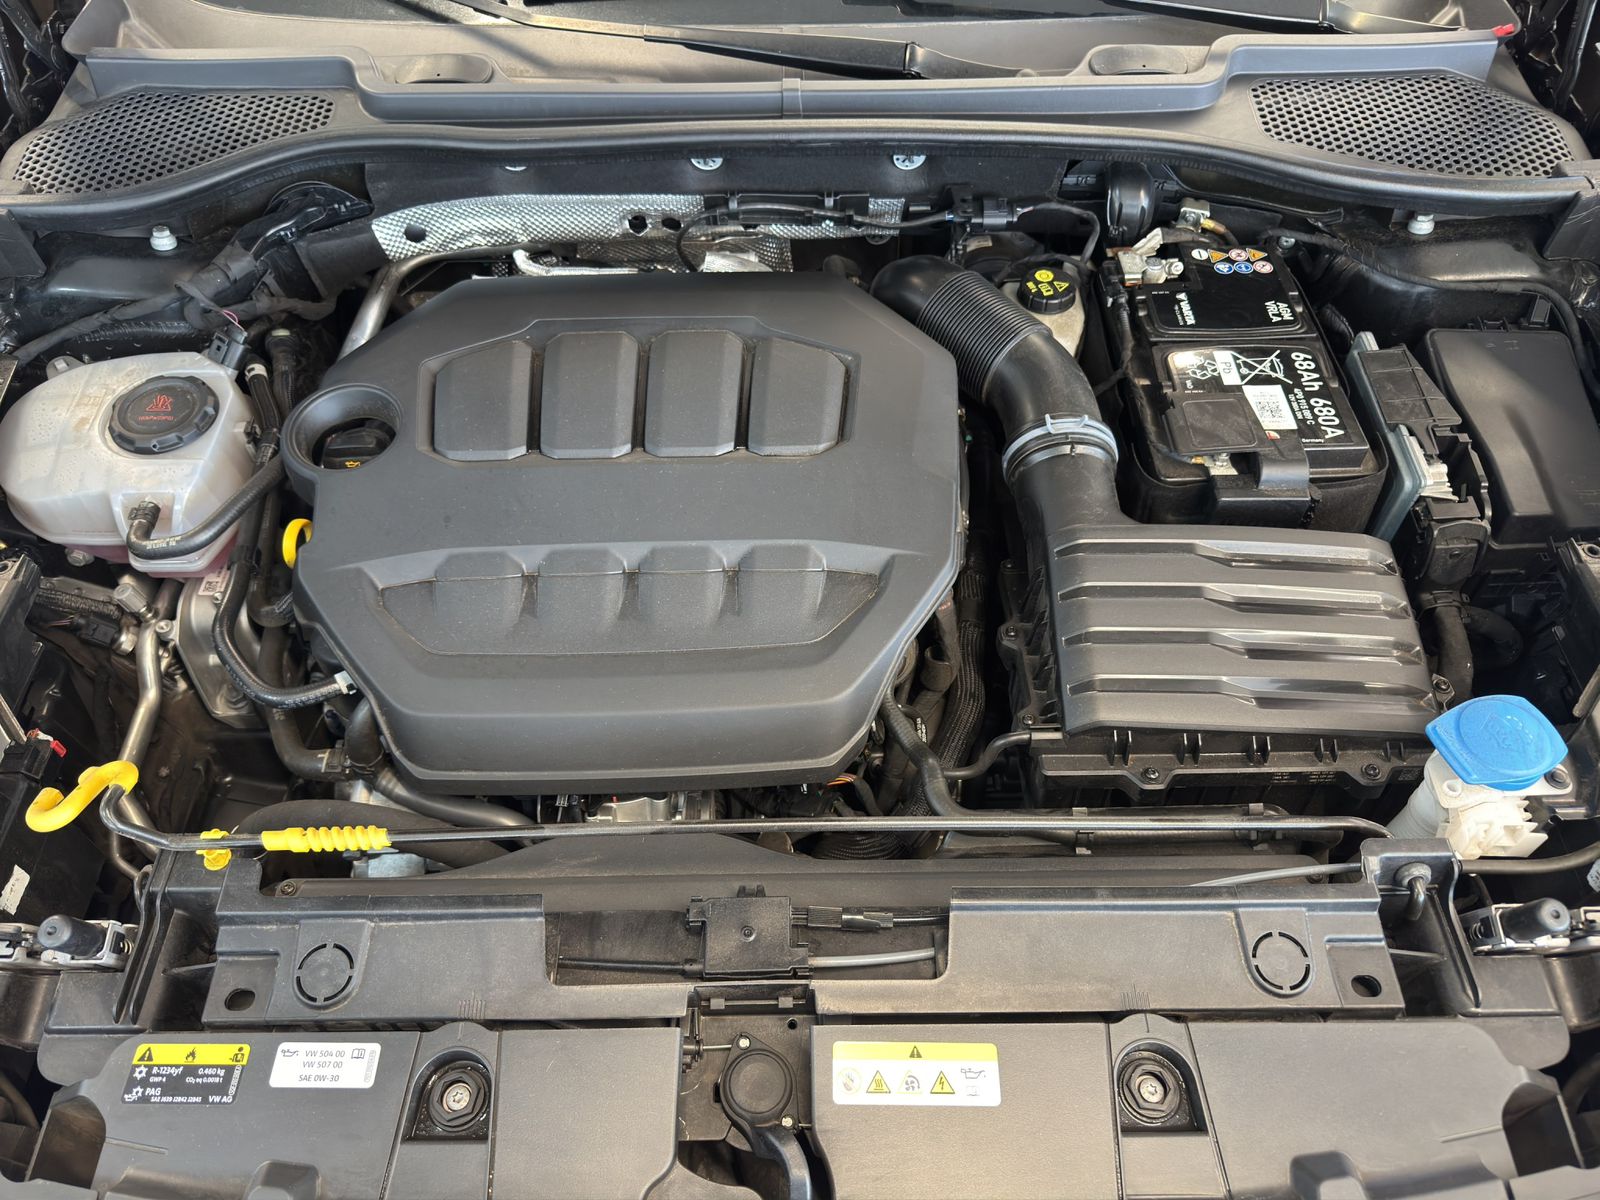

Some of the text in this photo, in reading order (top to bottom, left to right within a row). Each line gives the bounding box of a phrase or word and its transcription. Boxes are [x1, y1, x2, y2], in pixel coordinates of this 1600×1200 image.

[1180, 300, 1196, 325] VARTA
[1264, 300, 1282, 322] VRLA
[1276, 301, 1294, 320] AGM
[1221, 361, 1232, 374] Pb
[1291, 352, 1345, 439] 68Ah 680A
[319, 1050, 333, 1058] 504
[335, 1050, 346, 1058] 00
[333, 1061, 343, 1069] 00
[152, 1066, 226, 1077] R-1234yf 0.460 kg
[298, 1074, 340, 1082] SAE 0W-30
[145, 1087, 161, 1096] PAG
[208, 1095, 221, 1103] VW
[221, 1095, 233, 1103] AG
